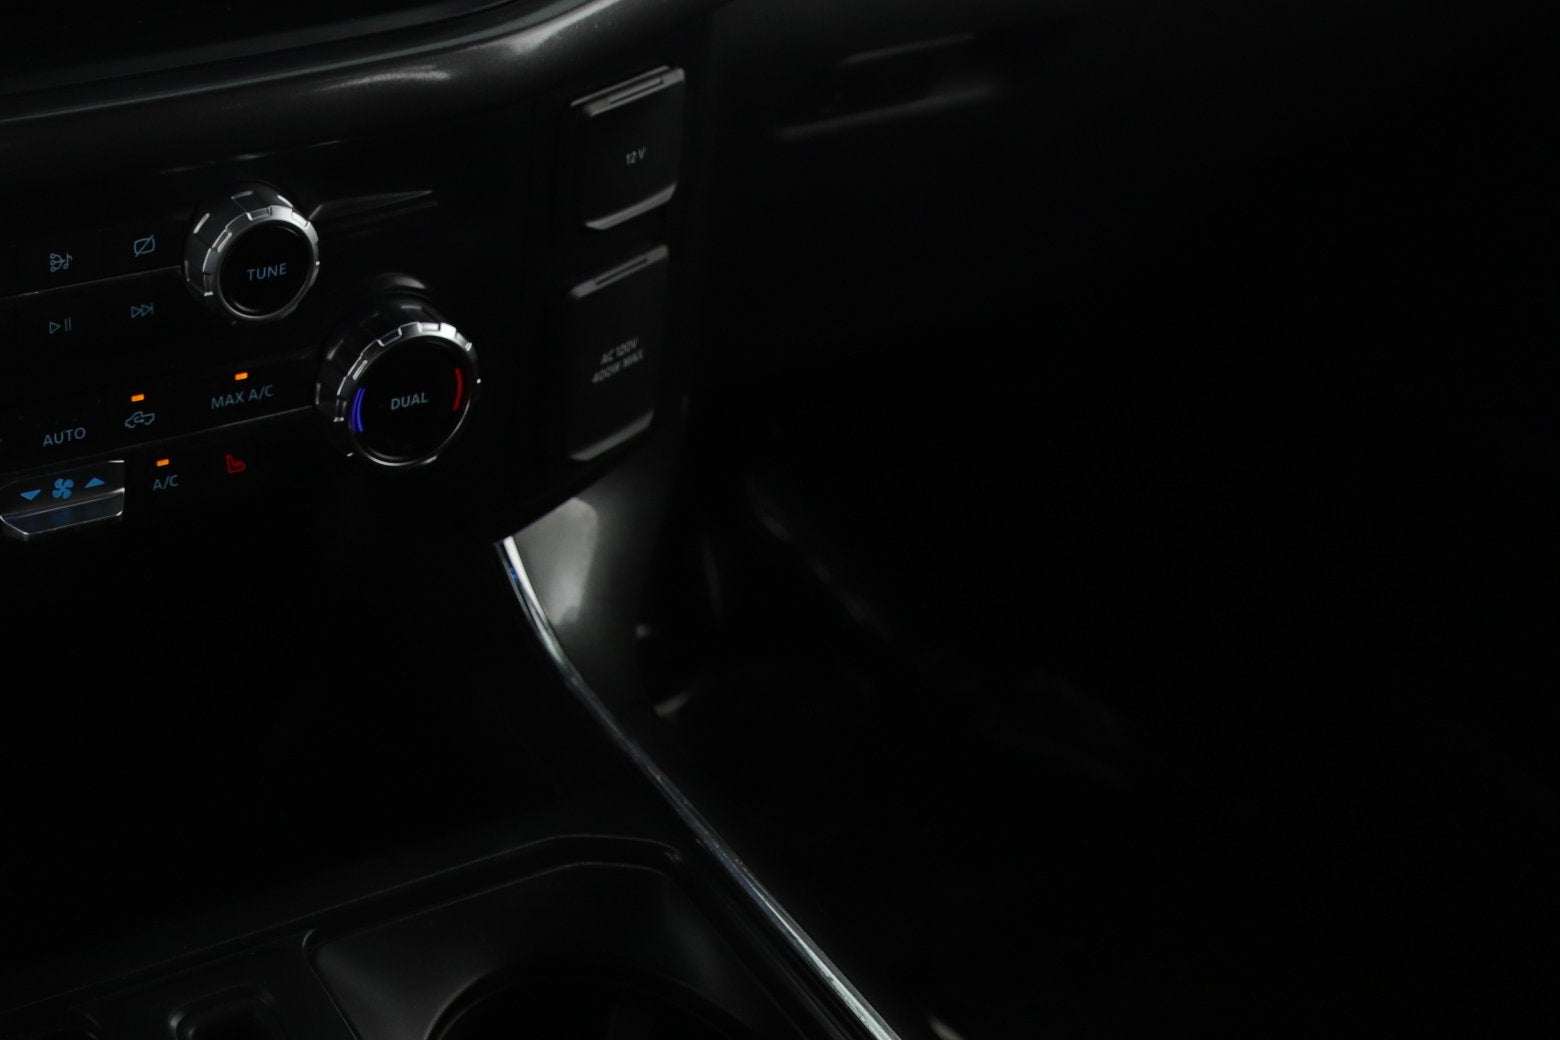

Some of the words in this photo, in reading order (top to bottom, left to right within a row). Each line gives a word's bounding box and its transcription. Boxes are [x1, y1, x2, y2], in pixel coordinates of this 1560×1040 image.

[246, 262, 288, 281] TUNE
[210, 390, 245, 410] MAX
[247, 384, 276, 401] A/C
[390, 392, 429, 410] DUAL
[42, 426, 87, 448] AUTO
[152, 474, 180, 491] A/C
